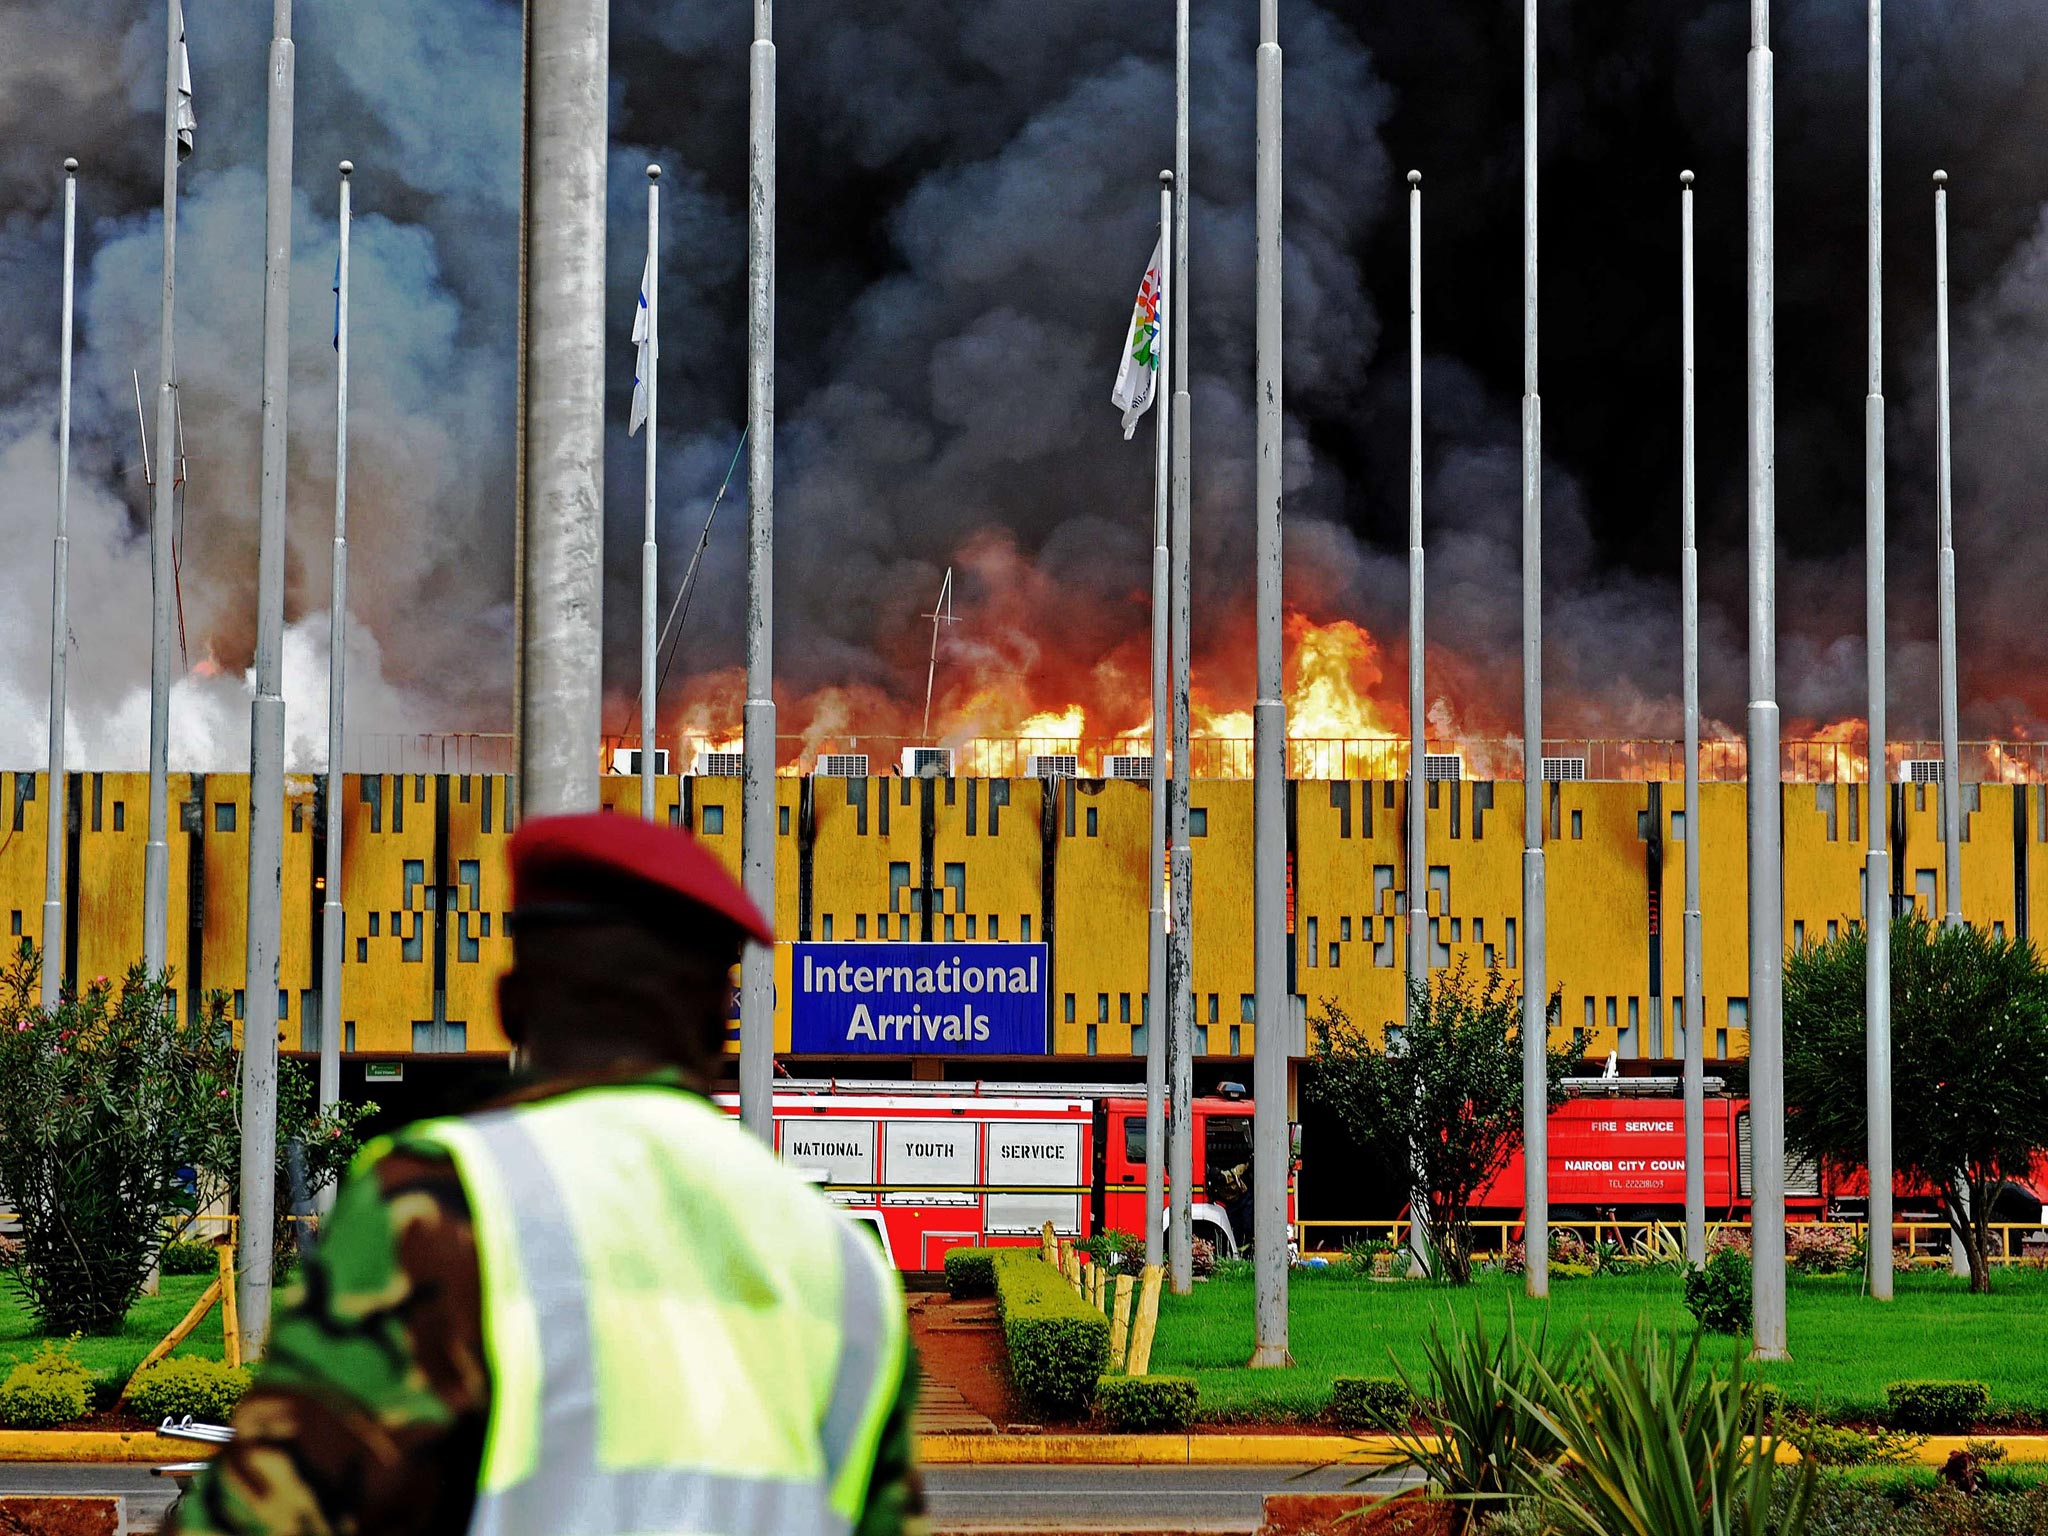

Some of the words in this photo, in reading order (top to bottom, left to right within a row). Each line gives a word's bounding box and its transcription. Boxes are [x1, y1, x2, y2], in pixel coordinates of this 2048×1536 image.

[803, 955, 1038, 994] International
[846, 1003, 990, 1042] Arrivals
[1591, 1121, 1617, 1132] FIRE
[1625, 1121, 1674, 1132] SERVICE
[793, 1142, 863, 1157] NATIONAL
[905, 1143, 954, 1158] YOUTH
[1001, 1145, 1065, 1160] SERVICE
[1564, 1160, 1613, 1171] NAIROBI
[1618, 1160, 1645, 1171] CITY
[1651, 1160, 1685, 1171] COUN
